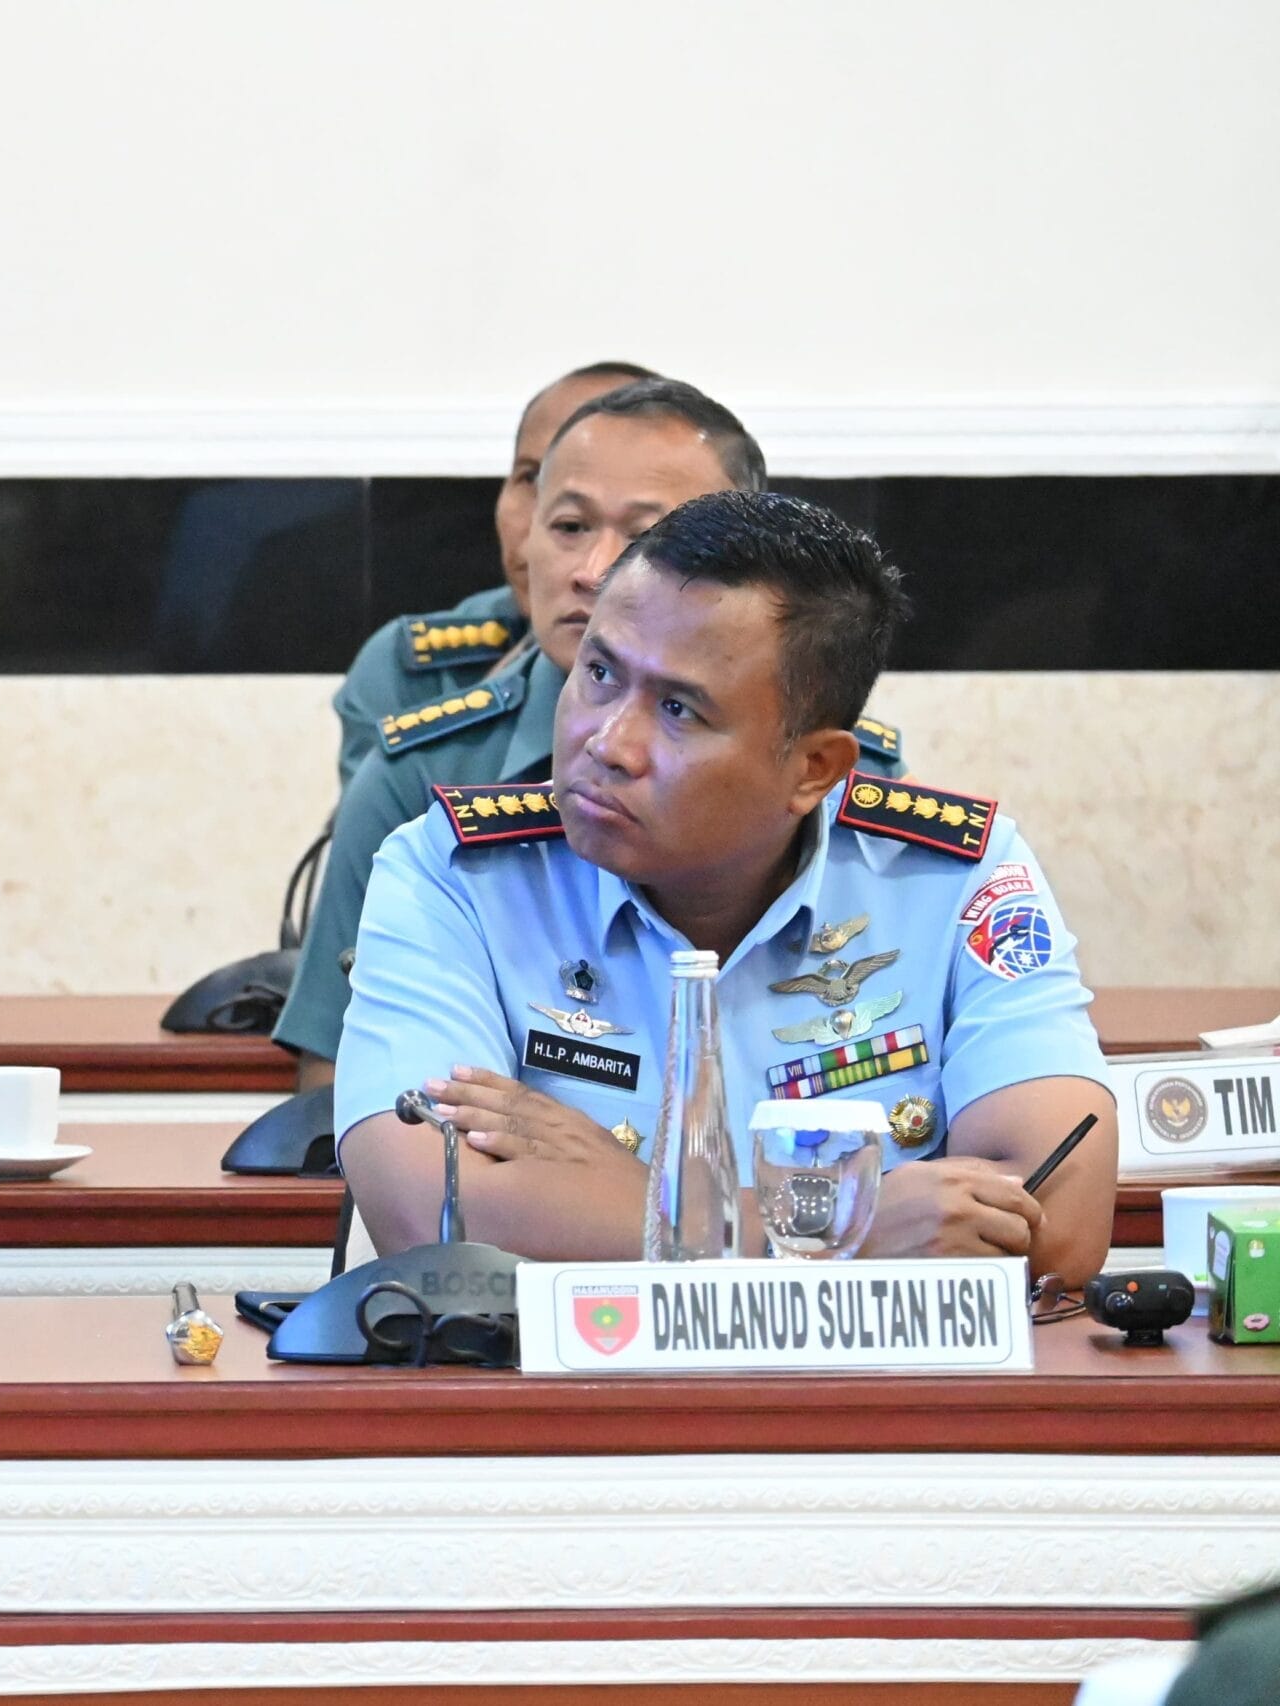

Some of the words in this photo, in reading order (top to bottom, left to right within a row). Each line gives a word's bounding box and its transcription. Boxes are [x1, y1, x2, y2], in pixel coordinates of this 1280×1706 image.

[445, 790, 478, 832] TNI
[962, 803, 990, 846] TNI
[965, 895, 992, 918] WING
[991, 881, 1031, 895] UDARA
[534, 1041, 569, 1062] H.L.P.
[572, 1051, 632, 1077] AMBARITA
[1213, 1076, 1276, 1136] TIM
[422, 1271, 517, 1297] BOSC
[651, 1281, 808, 1351] DANLANUD
[817, 1280, 929, 1350] SULTAN
[937, 1278, 998, 1348] HSN
